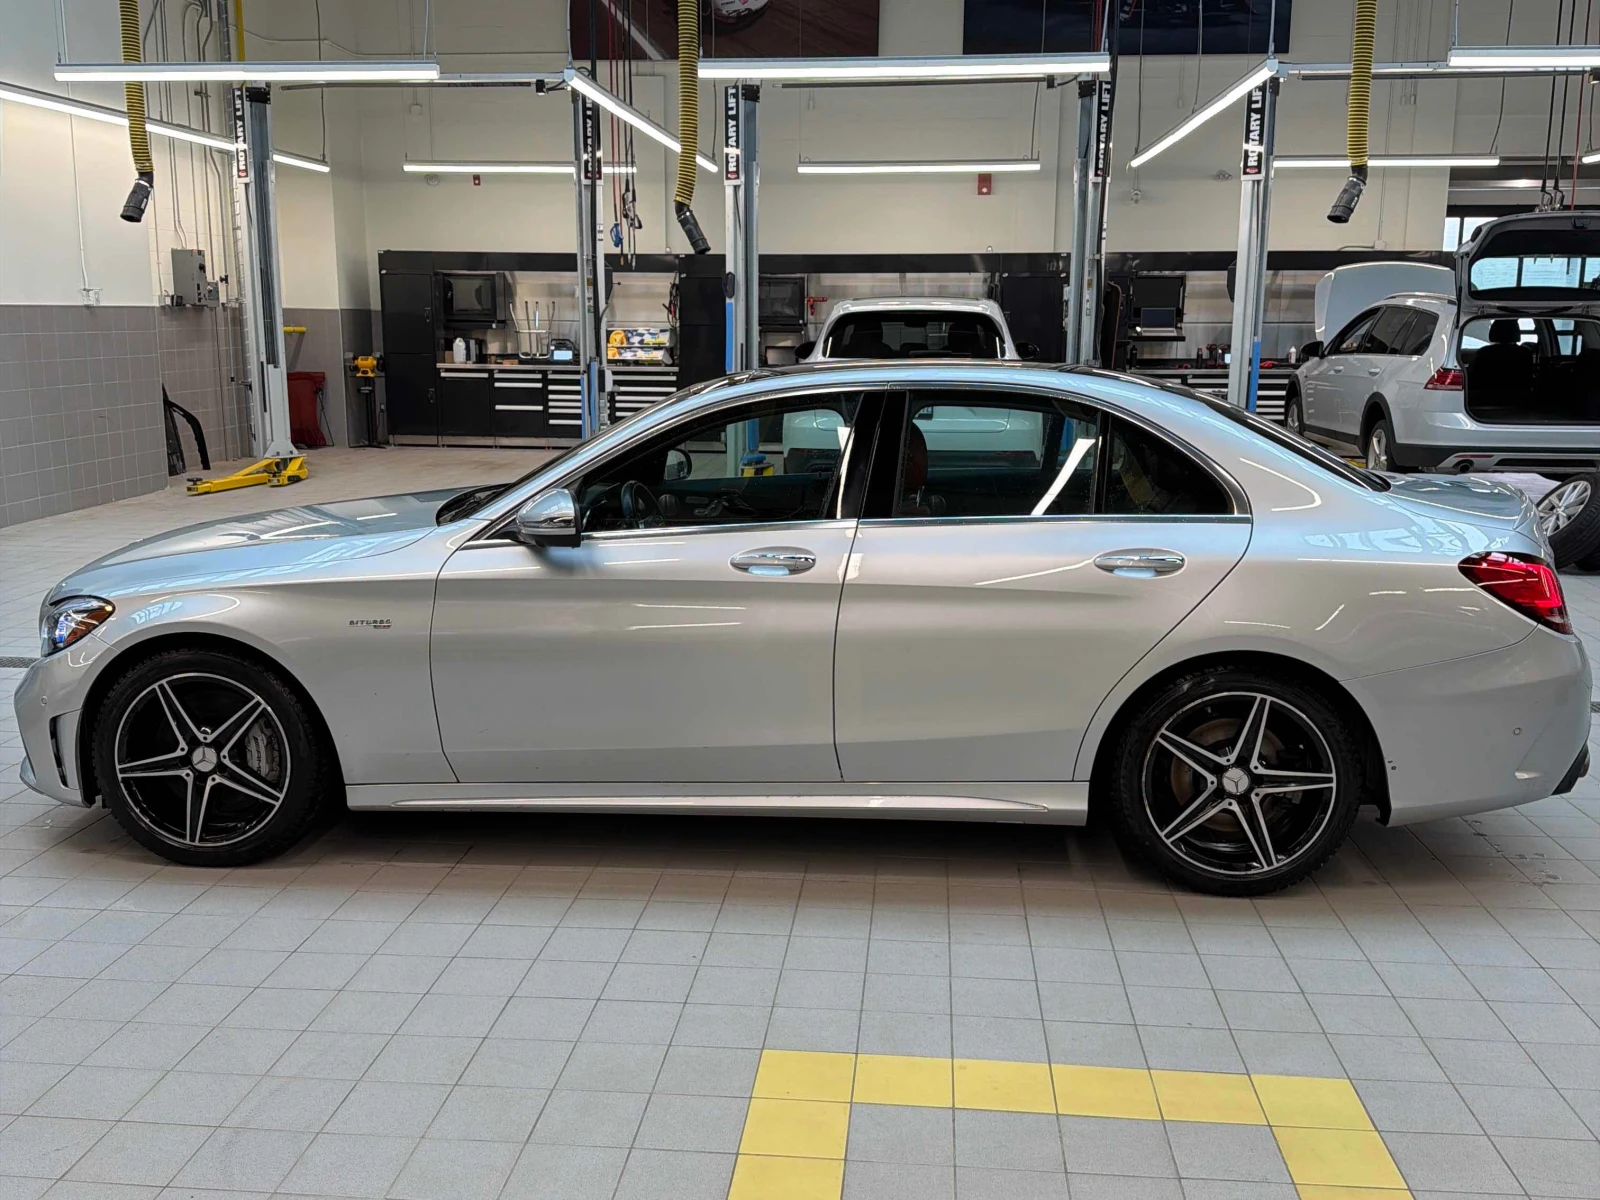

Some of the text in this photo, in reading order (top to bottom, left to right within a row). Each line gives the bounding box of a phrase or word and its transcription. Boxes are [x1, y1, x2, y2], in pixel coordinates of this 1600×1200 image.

[234, 89, 243, 116] LIFT
[1101, 82, 1111, 111] LIFT
[1251, 83, 1263, 109] LIF
[727, 86, 737, 172] ROARY LIFT
[1247, 112, 1261, 166] ROTARY
